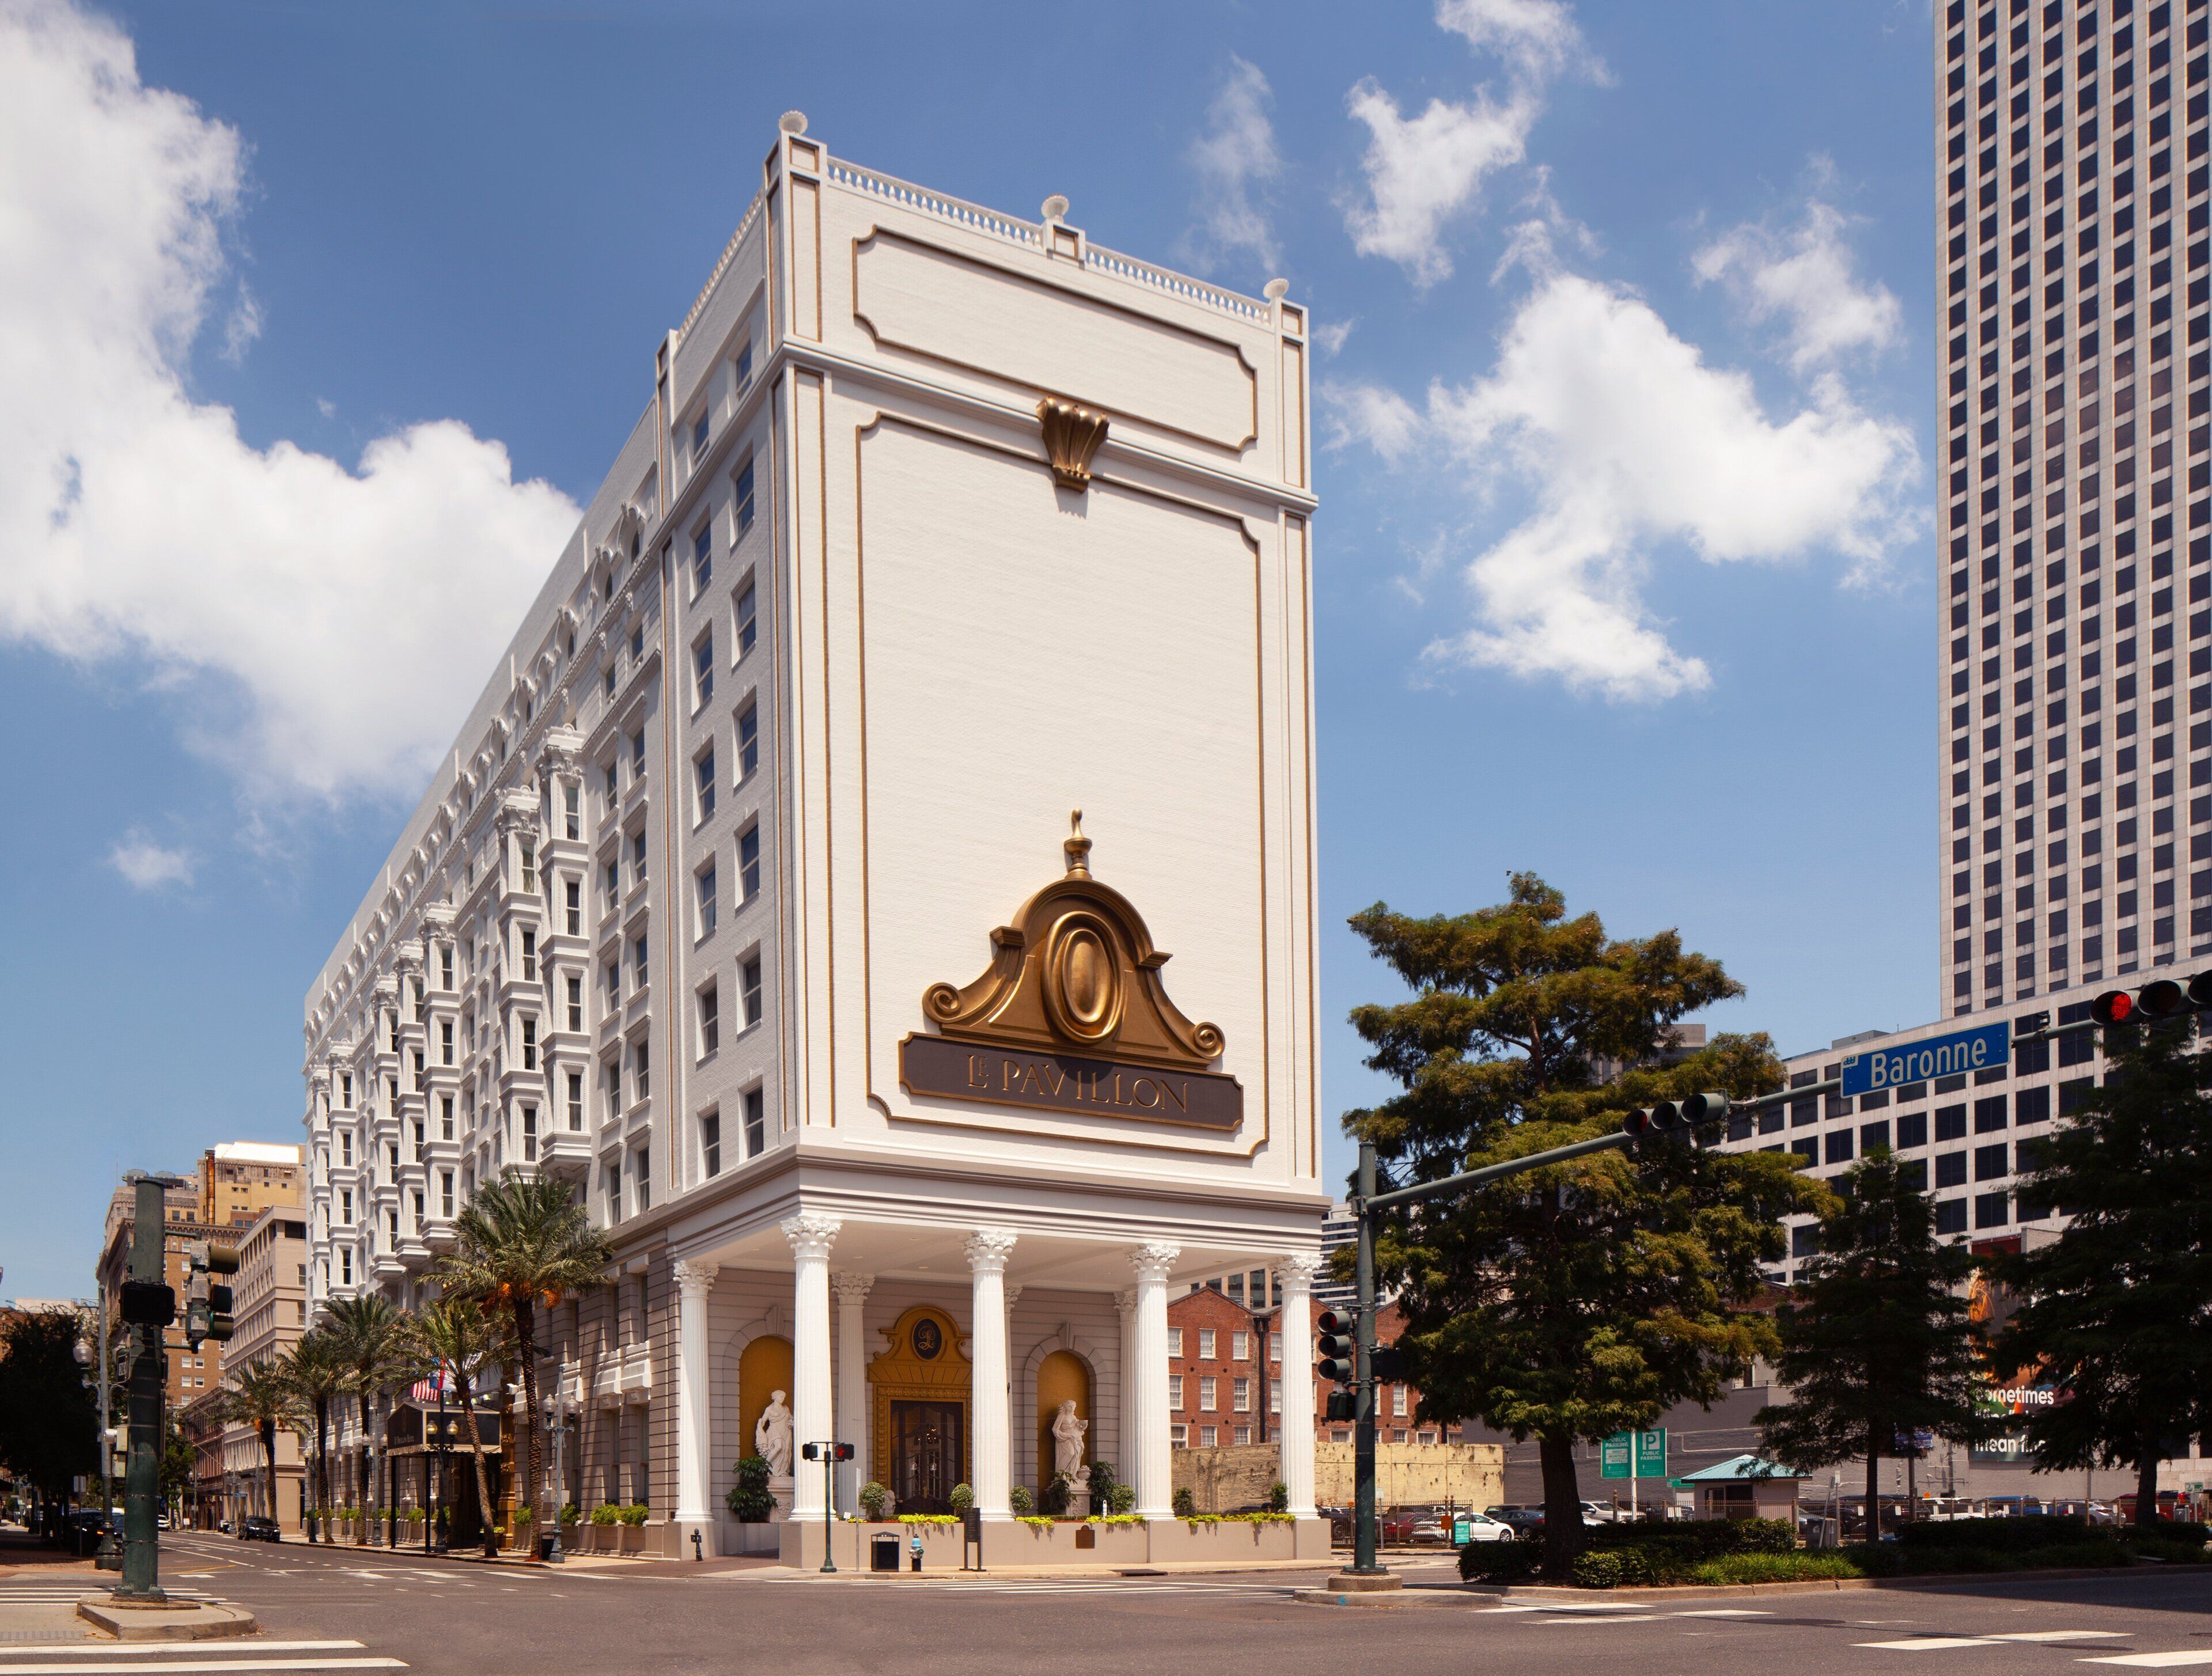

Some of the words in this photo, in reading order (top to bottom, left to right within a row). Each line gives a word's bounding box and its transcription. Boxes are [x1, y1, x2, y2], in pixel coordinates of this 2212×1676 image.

[967, 1055, 989, 1088] LE
[1002, 1059, 1187, 1113] PAVILLON
[1871, 1038, 1987, 1088] Baronne
